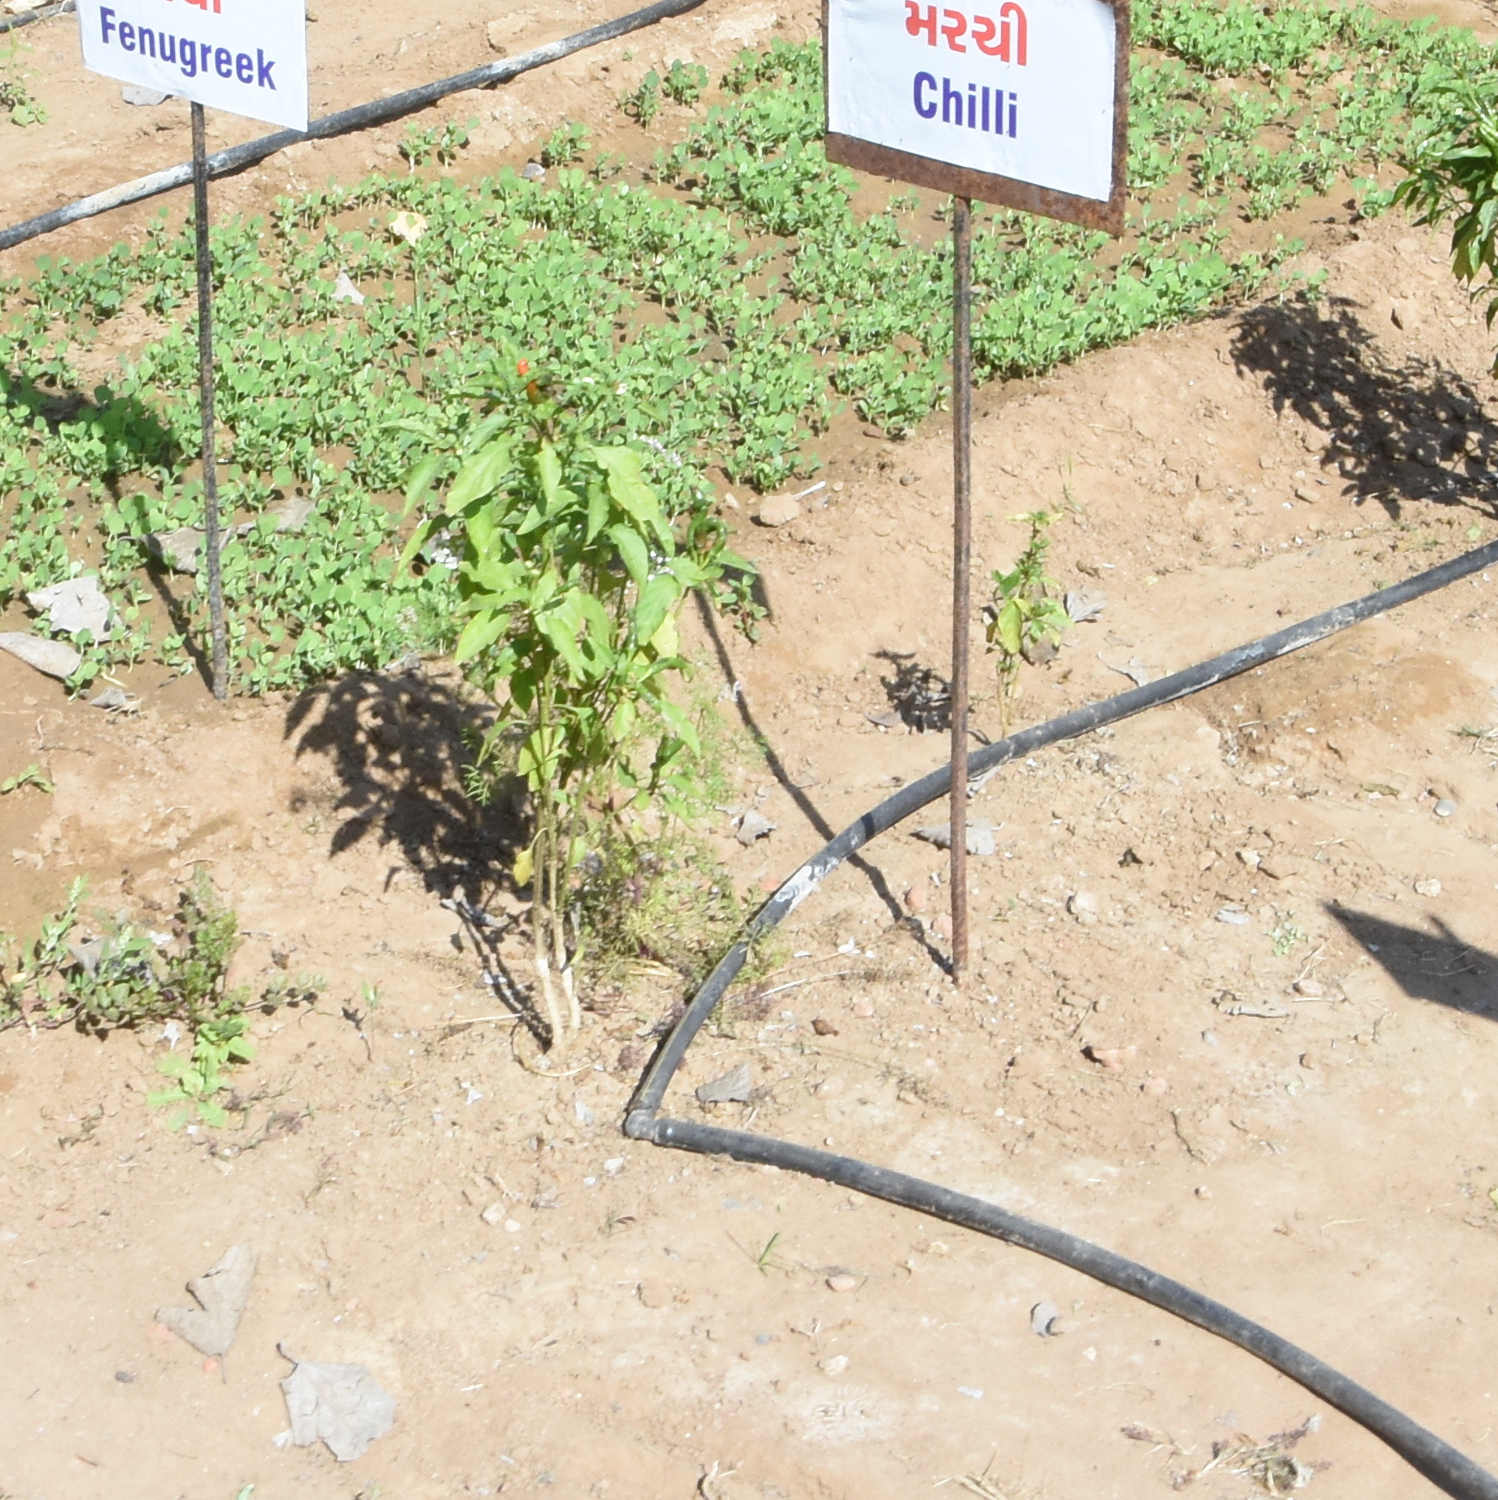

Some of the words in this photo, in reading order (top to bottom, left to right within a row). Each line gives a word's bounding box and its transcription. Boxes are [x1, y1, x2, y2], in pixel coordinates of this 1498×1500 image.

[99, 5, 277, 91] Fenugreek
[904, 0, 1028, 67] મરચી
[913, 70, 1018, 139] Chilli
